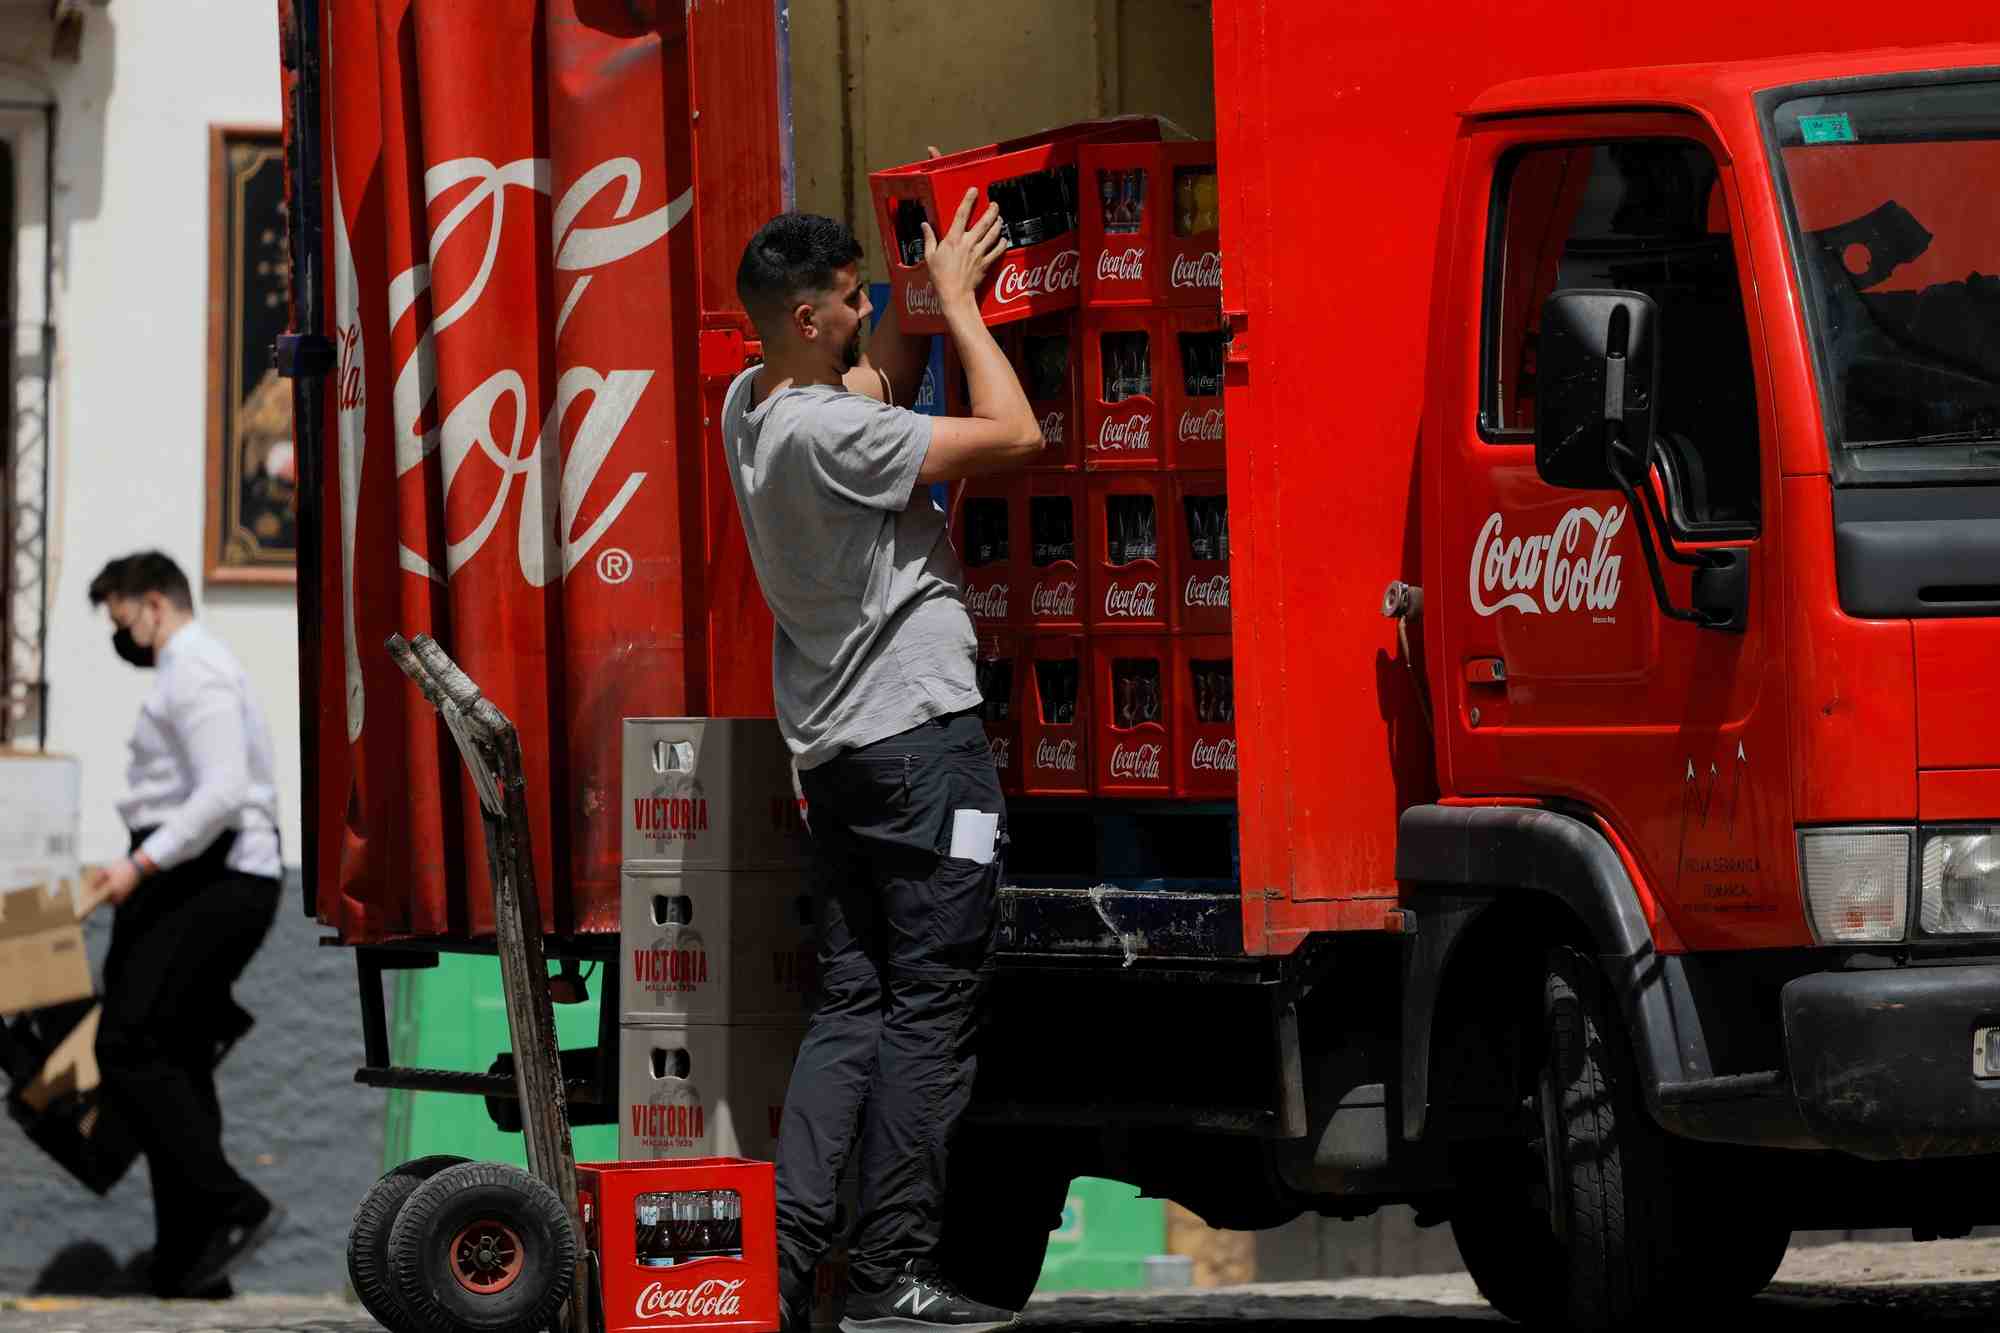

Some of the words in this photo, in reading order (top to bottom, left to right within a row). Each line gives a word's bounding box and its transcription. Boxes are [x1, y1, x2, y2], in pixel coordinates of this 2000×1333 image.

[994, 249, 1080, 304] Coca-Col
[1097, 249, 1145, 281] Coca-Cola
[1100, 414, 1152, 450] Coca-Cola
[1469, 503, 1628, 616] Coca-Cola
[1031, 581, 1078, 616] Coca-Cola
[1105, 581, 1156, 616] Coca-Cola
[1185, 574, 1230, 608] Coca-Cola
[1036, 737, 1077, 771] Coca-Cola
[1110, 743, 1162, 779] Coca-Cola
[1191, 737, 1237, 770] Coca-Cola
[633, 798, 708, 831] VICTORIA
[634, 950, 708, 983] VICTORIA
[631, 1104, 704, 1138] VICTORIA
[635, 1279, 748, 1320] Coca-Cola
